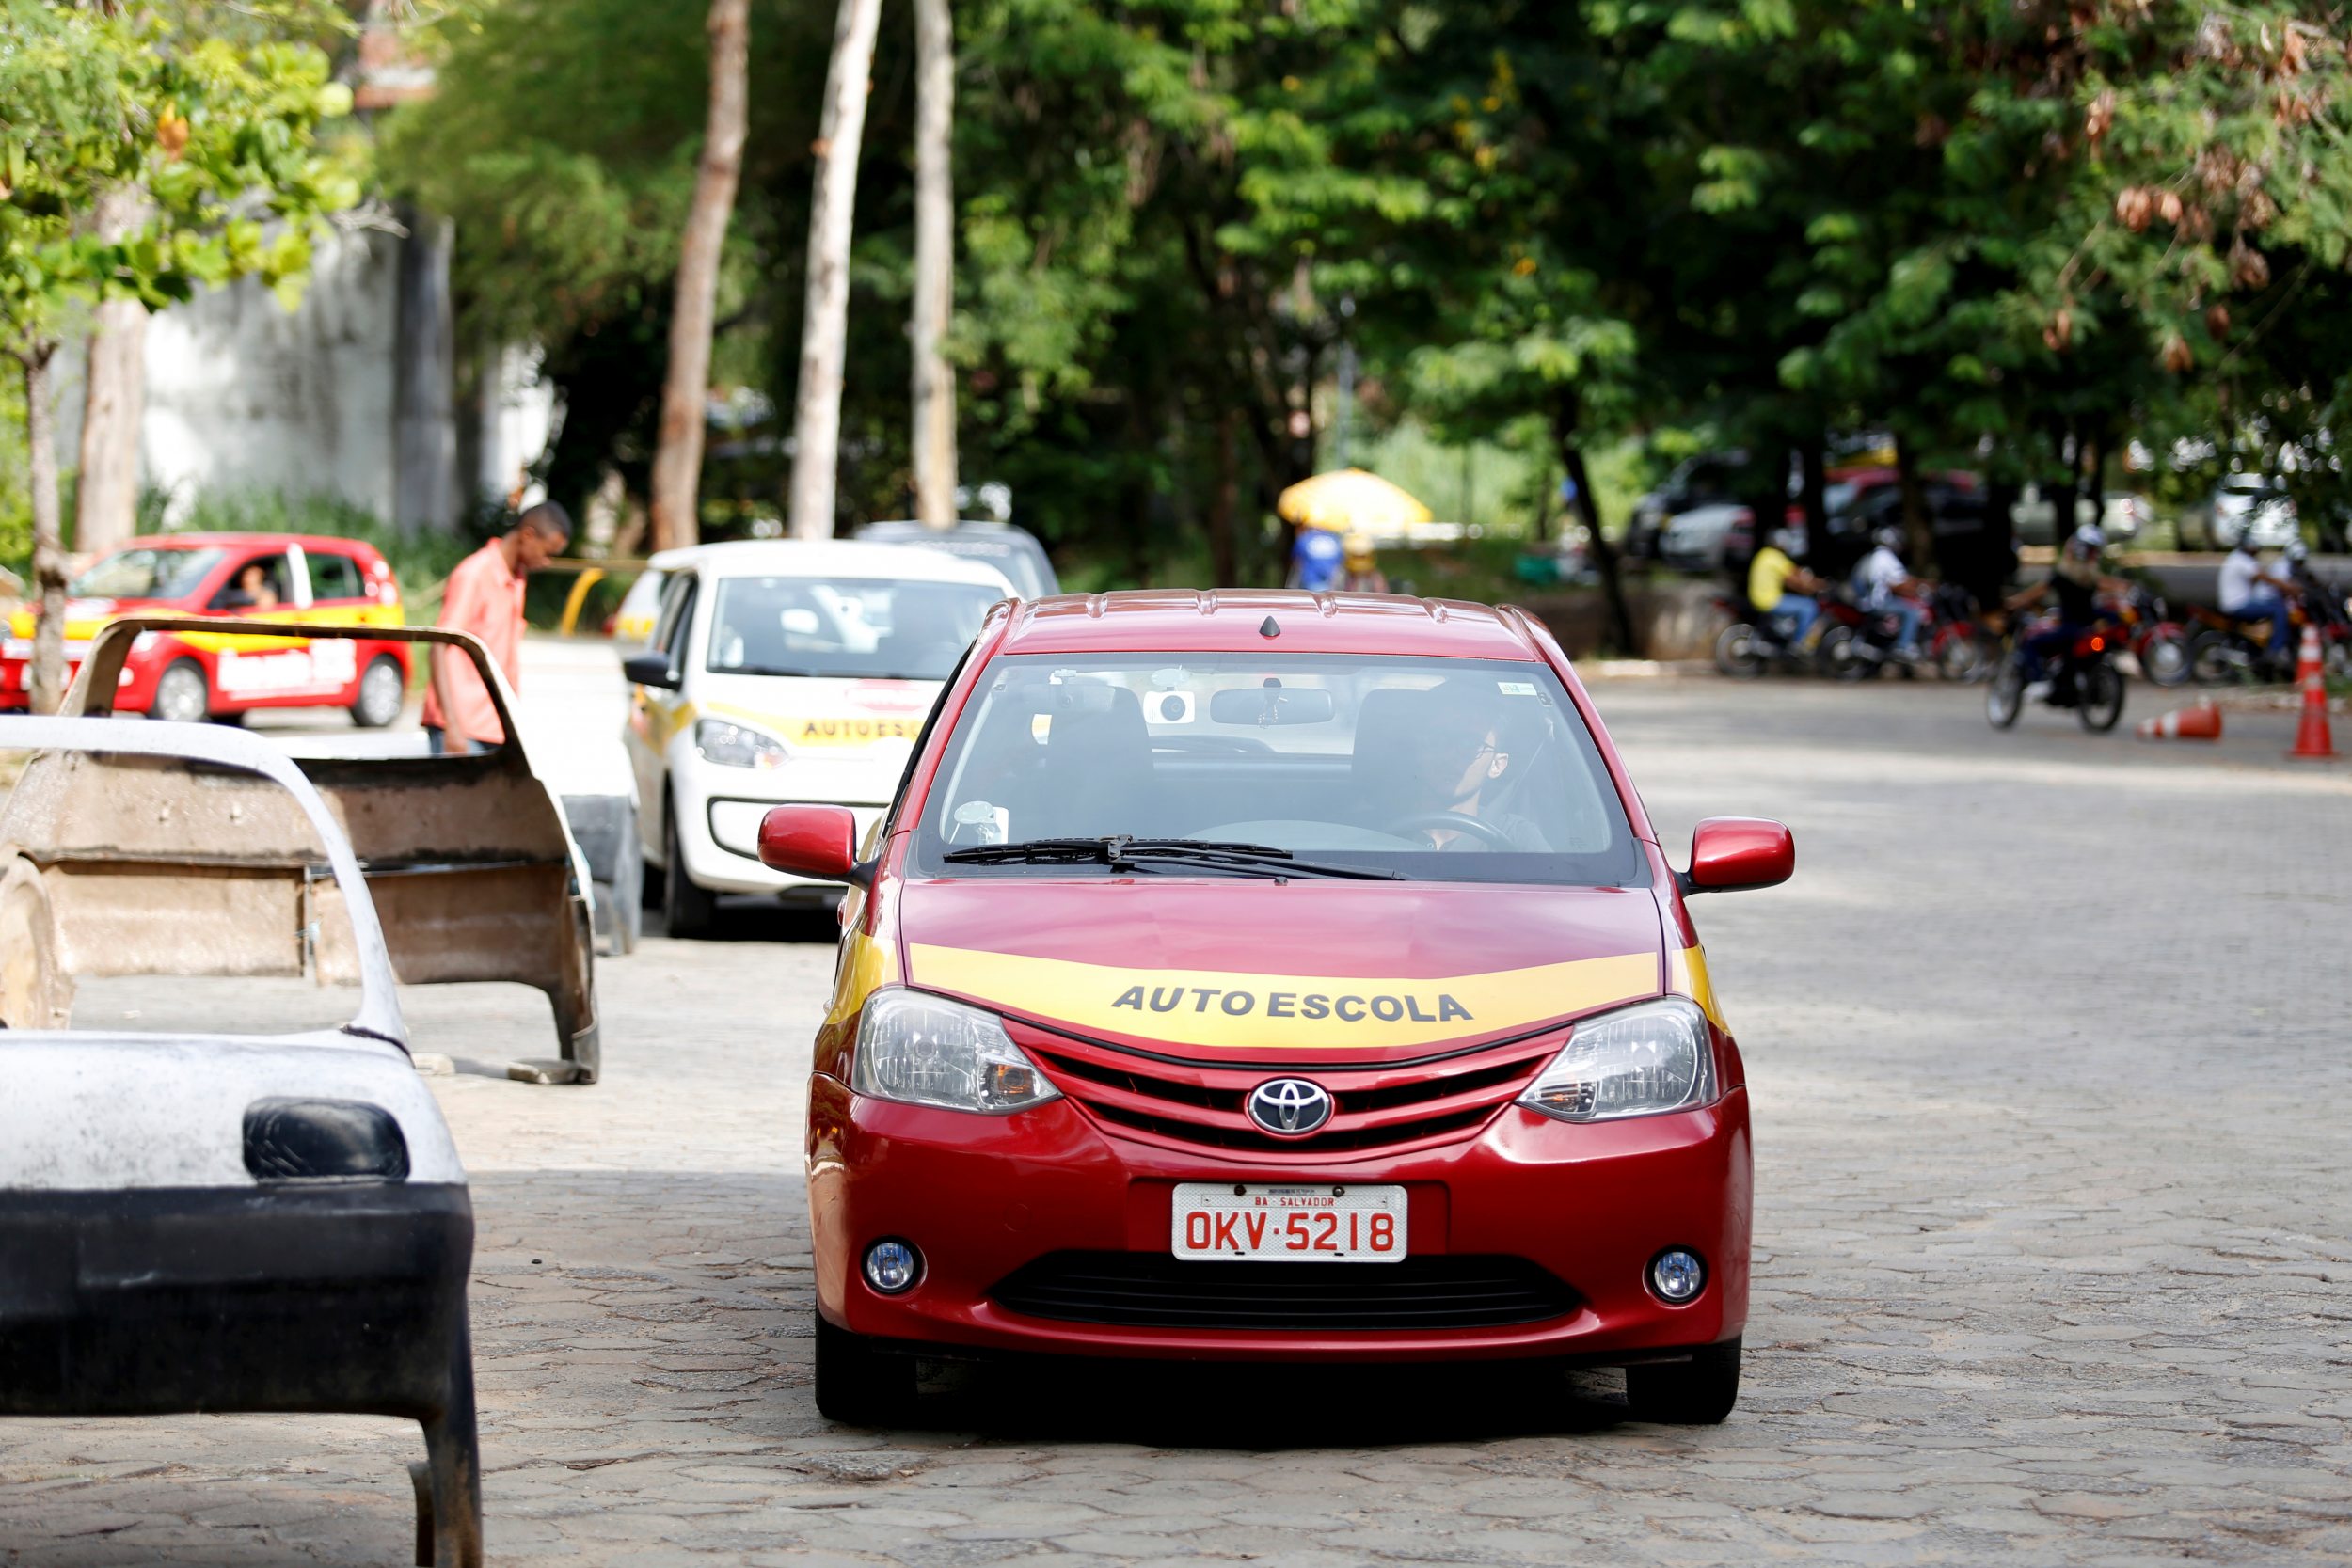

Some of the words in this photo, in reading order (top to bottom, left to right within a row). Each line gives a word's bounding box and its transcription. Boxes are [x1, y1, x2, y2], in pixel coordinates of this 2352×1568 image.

[1111, 985, 1256, 1017] AUTO
[1266, 991, 1475, 1023] ESCOLA
[1254, 1196, 1269, 1206] BA
[1279, 1196, 1335, 1207] SALVADOR
